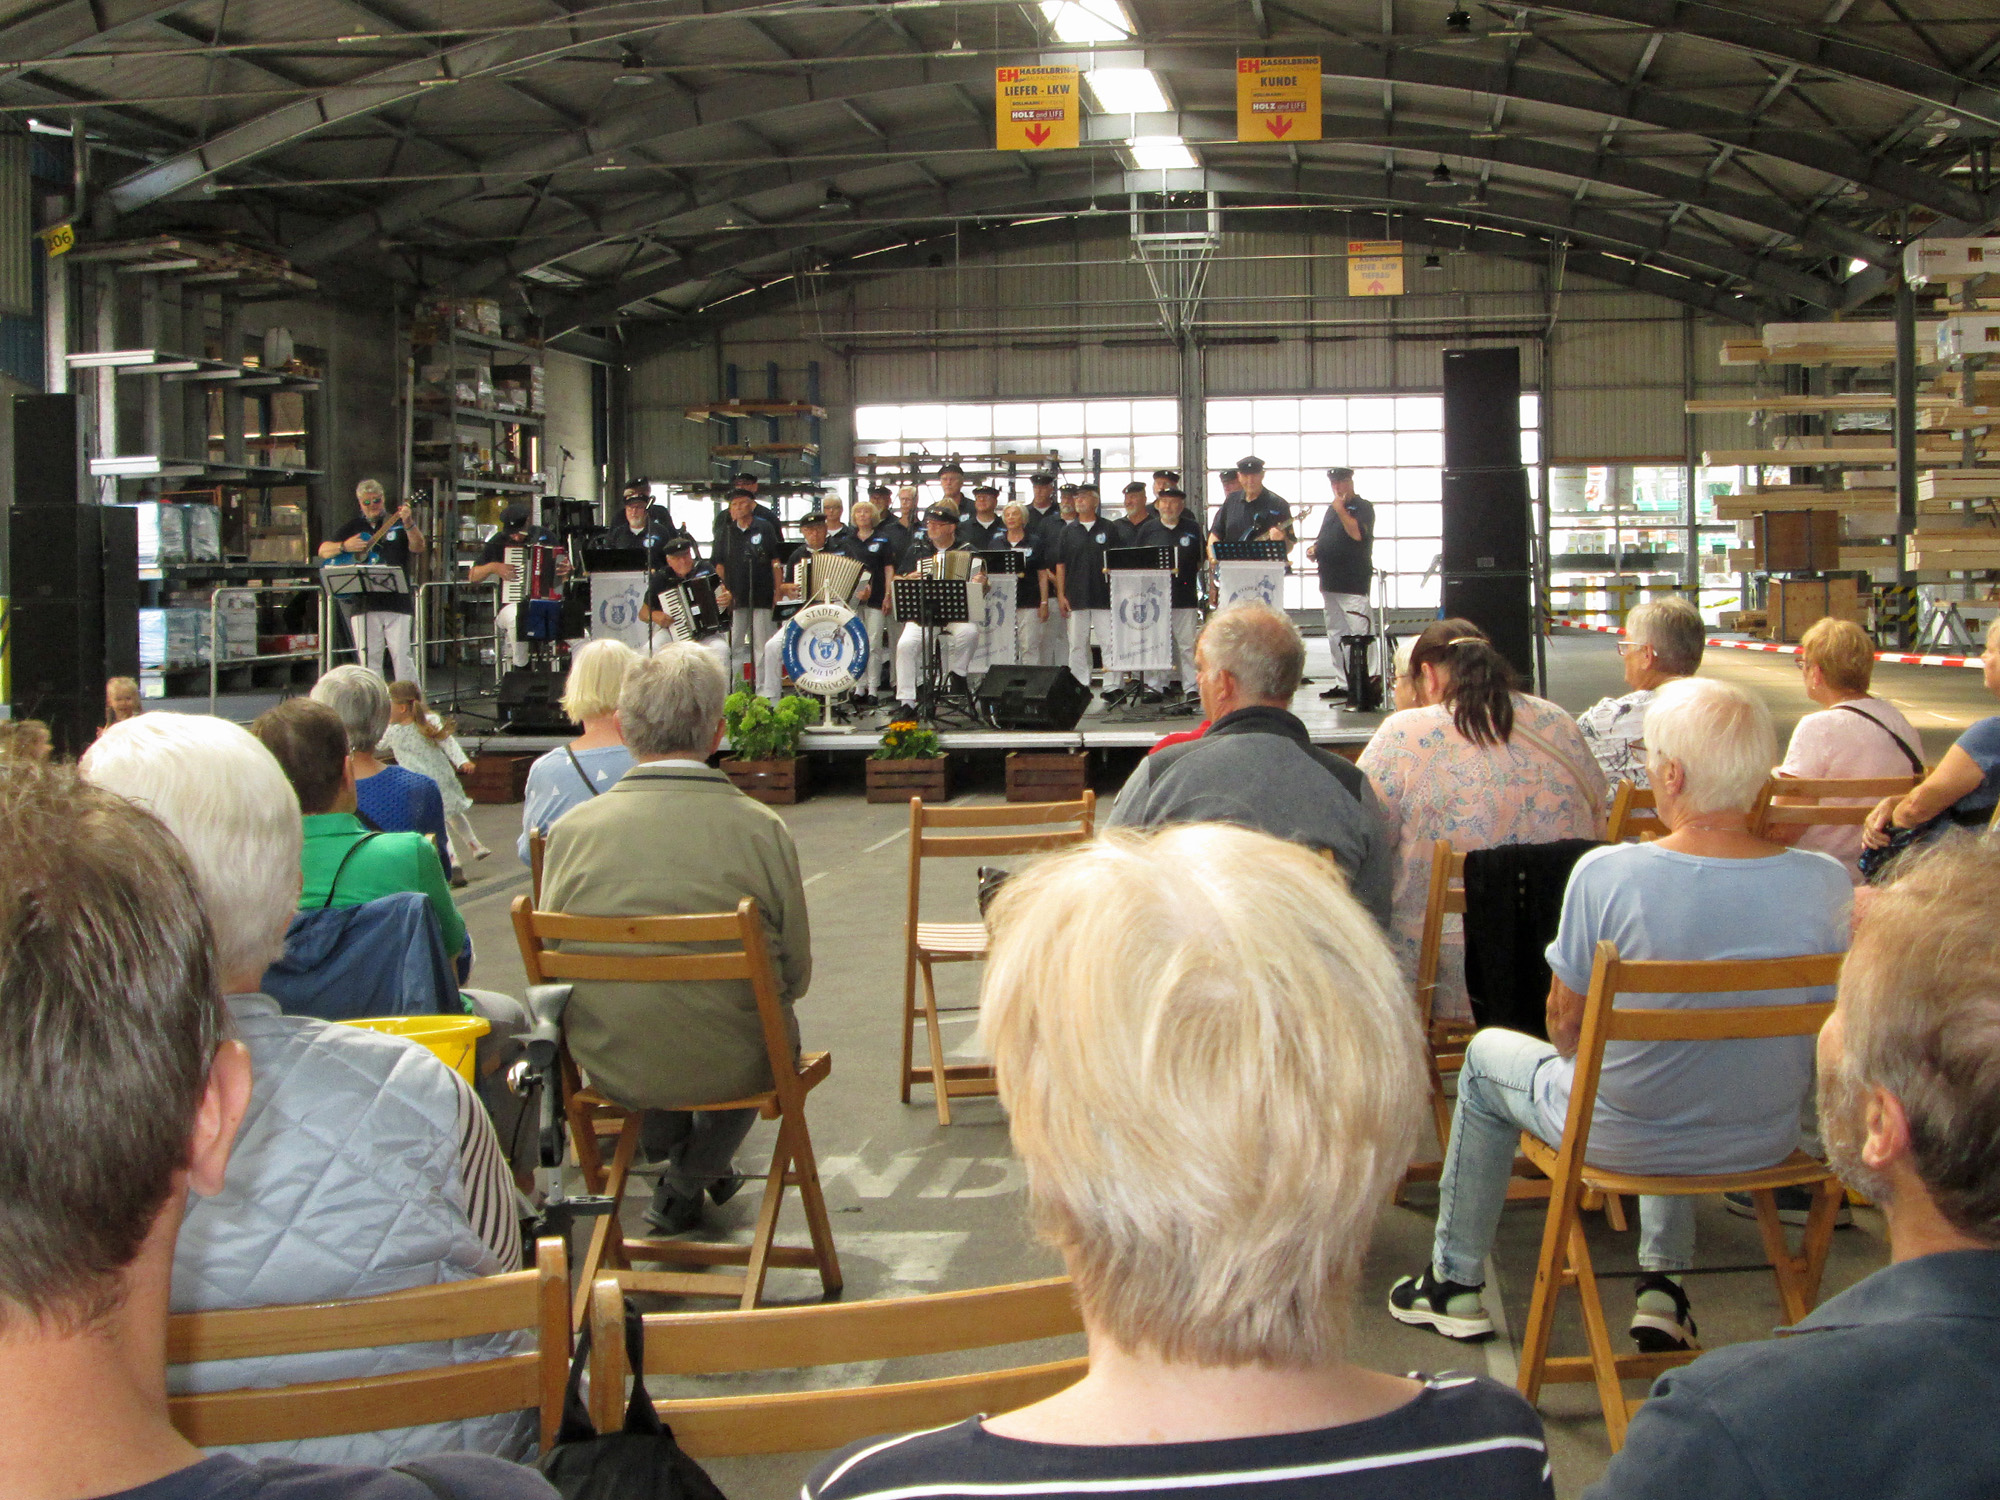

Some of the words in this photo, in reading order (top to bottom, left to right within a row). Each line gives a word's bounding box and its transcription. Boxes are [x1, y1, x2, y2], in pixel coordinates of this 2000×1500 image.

[1239, 60, 1260, 73] EH
[998, 69, 1019, 82] EH
[1261, 76, 1297, 87] KUNDE
[1005, 85, 1038, 97] LIEFER
[1047, 84, 1070, 95] LKW
[1291, 101, 1306, 109] LIFE
[1012, 111, 1035, 119] HOLZ
[1049, 109, 1064, 118] LIFE
[805, 608, 841, 620] STADER
[810, 666, 823, 676] seit
